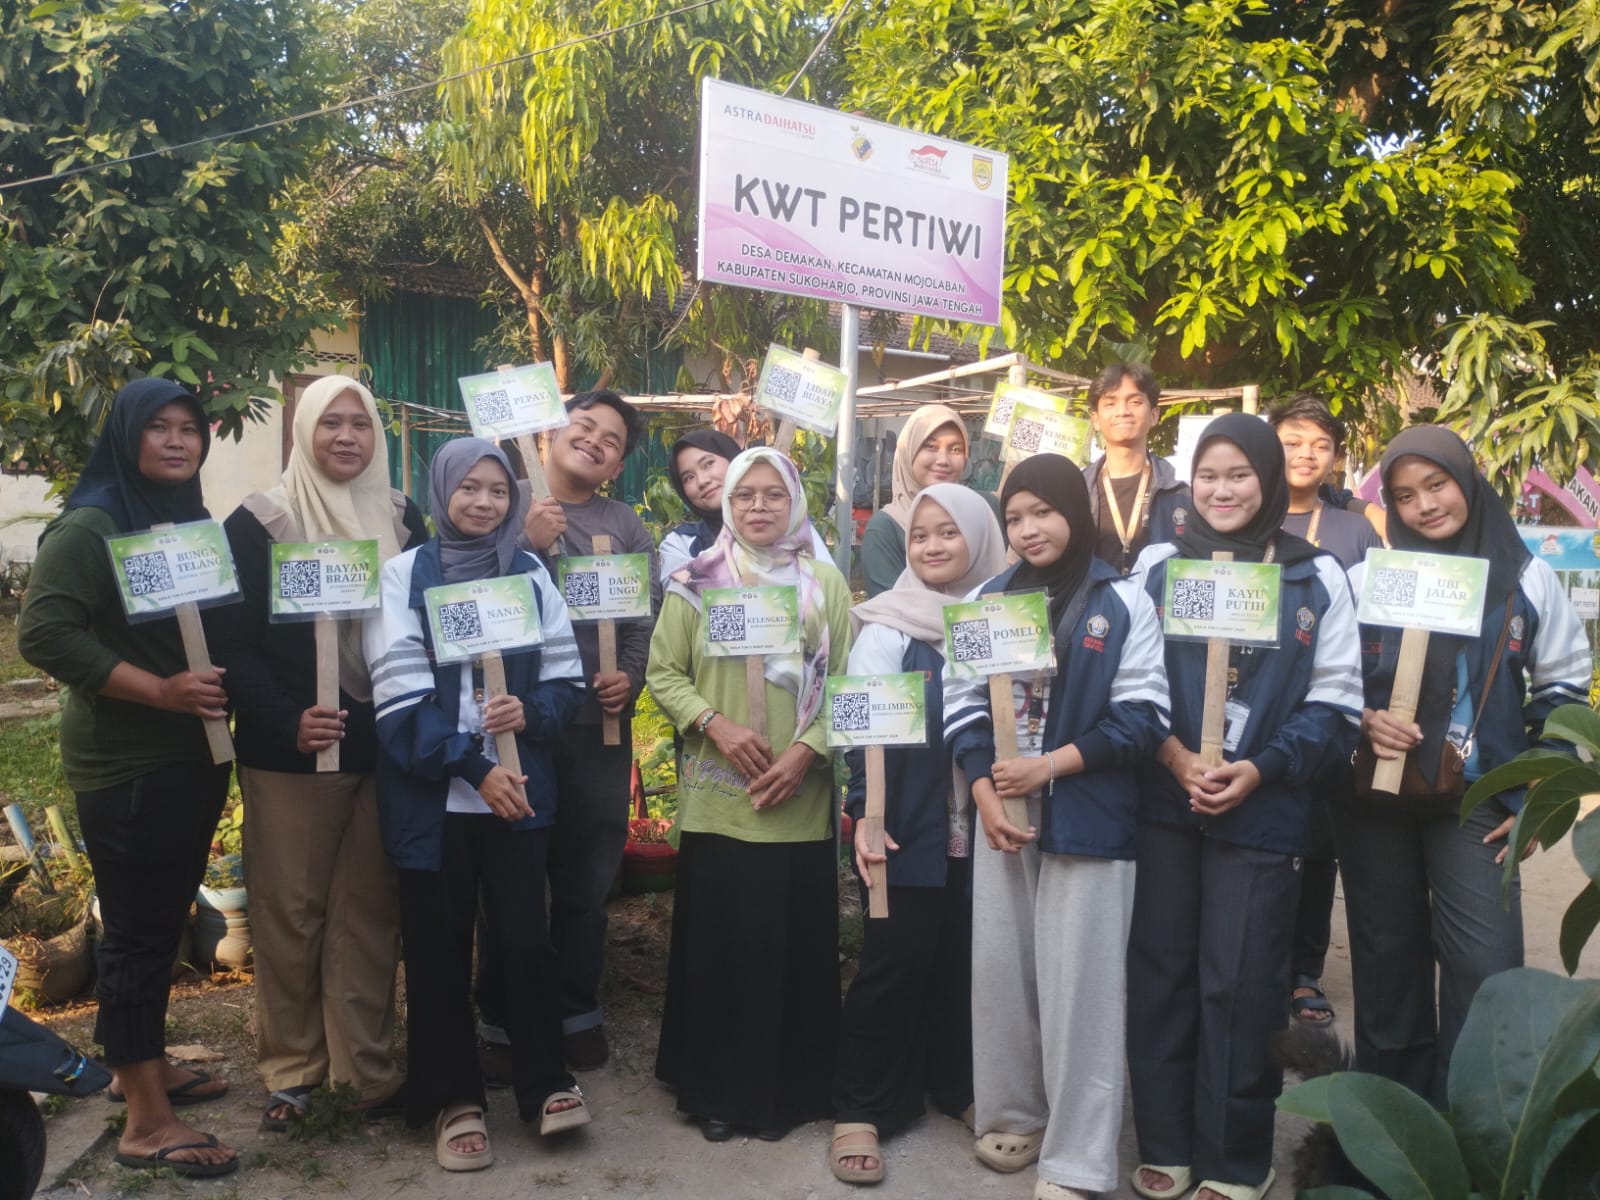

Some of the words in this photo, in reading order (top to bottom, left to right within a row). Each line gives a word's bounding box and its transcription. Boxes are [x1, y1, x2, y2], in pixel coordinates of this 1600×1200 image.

[734, 173, 827, 227] KWT
[839, 196, 981, 259] PERTIWI
[741, 243, 772, 259] DESA
[775, 249, 835, 271] DEMAKAN,
[837, 260, 902, 283] KECAMATAN
[904, 273, 966, 293] MOJOLABAN
[716, 260, 786, 282] KABUPATEN
[788, 272, 859, 297] SUKOHARJO,
[862, 285, 911, 304] PROVINSI
[912, 294, 939, 309] JAWA
[942, 298, 983, 316] TENGAH
[177, 547, 218, 562] BUNGA
[176, 557, 223, 573] TELANG
[326, 562, 369, 573] BAYAM
[326, 573, 369, 584] BRAZIL
[608, 576, 638, 585] DAUN
[1437, 579, 1459, 589] UBI
[609, 586, 638, 595] UNGU
[1228, 588, 1264, 599] KAYU
[1425, 588, 1467, 600] JALAR
[1225, 599, 1265, 611] PUTIH
[487, 604, 528, 619] NANAS
[993, 625, 1044, 640] POMELO
[871, 703, 923, 711] BELIMBING
